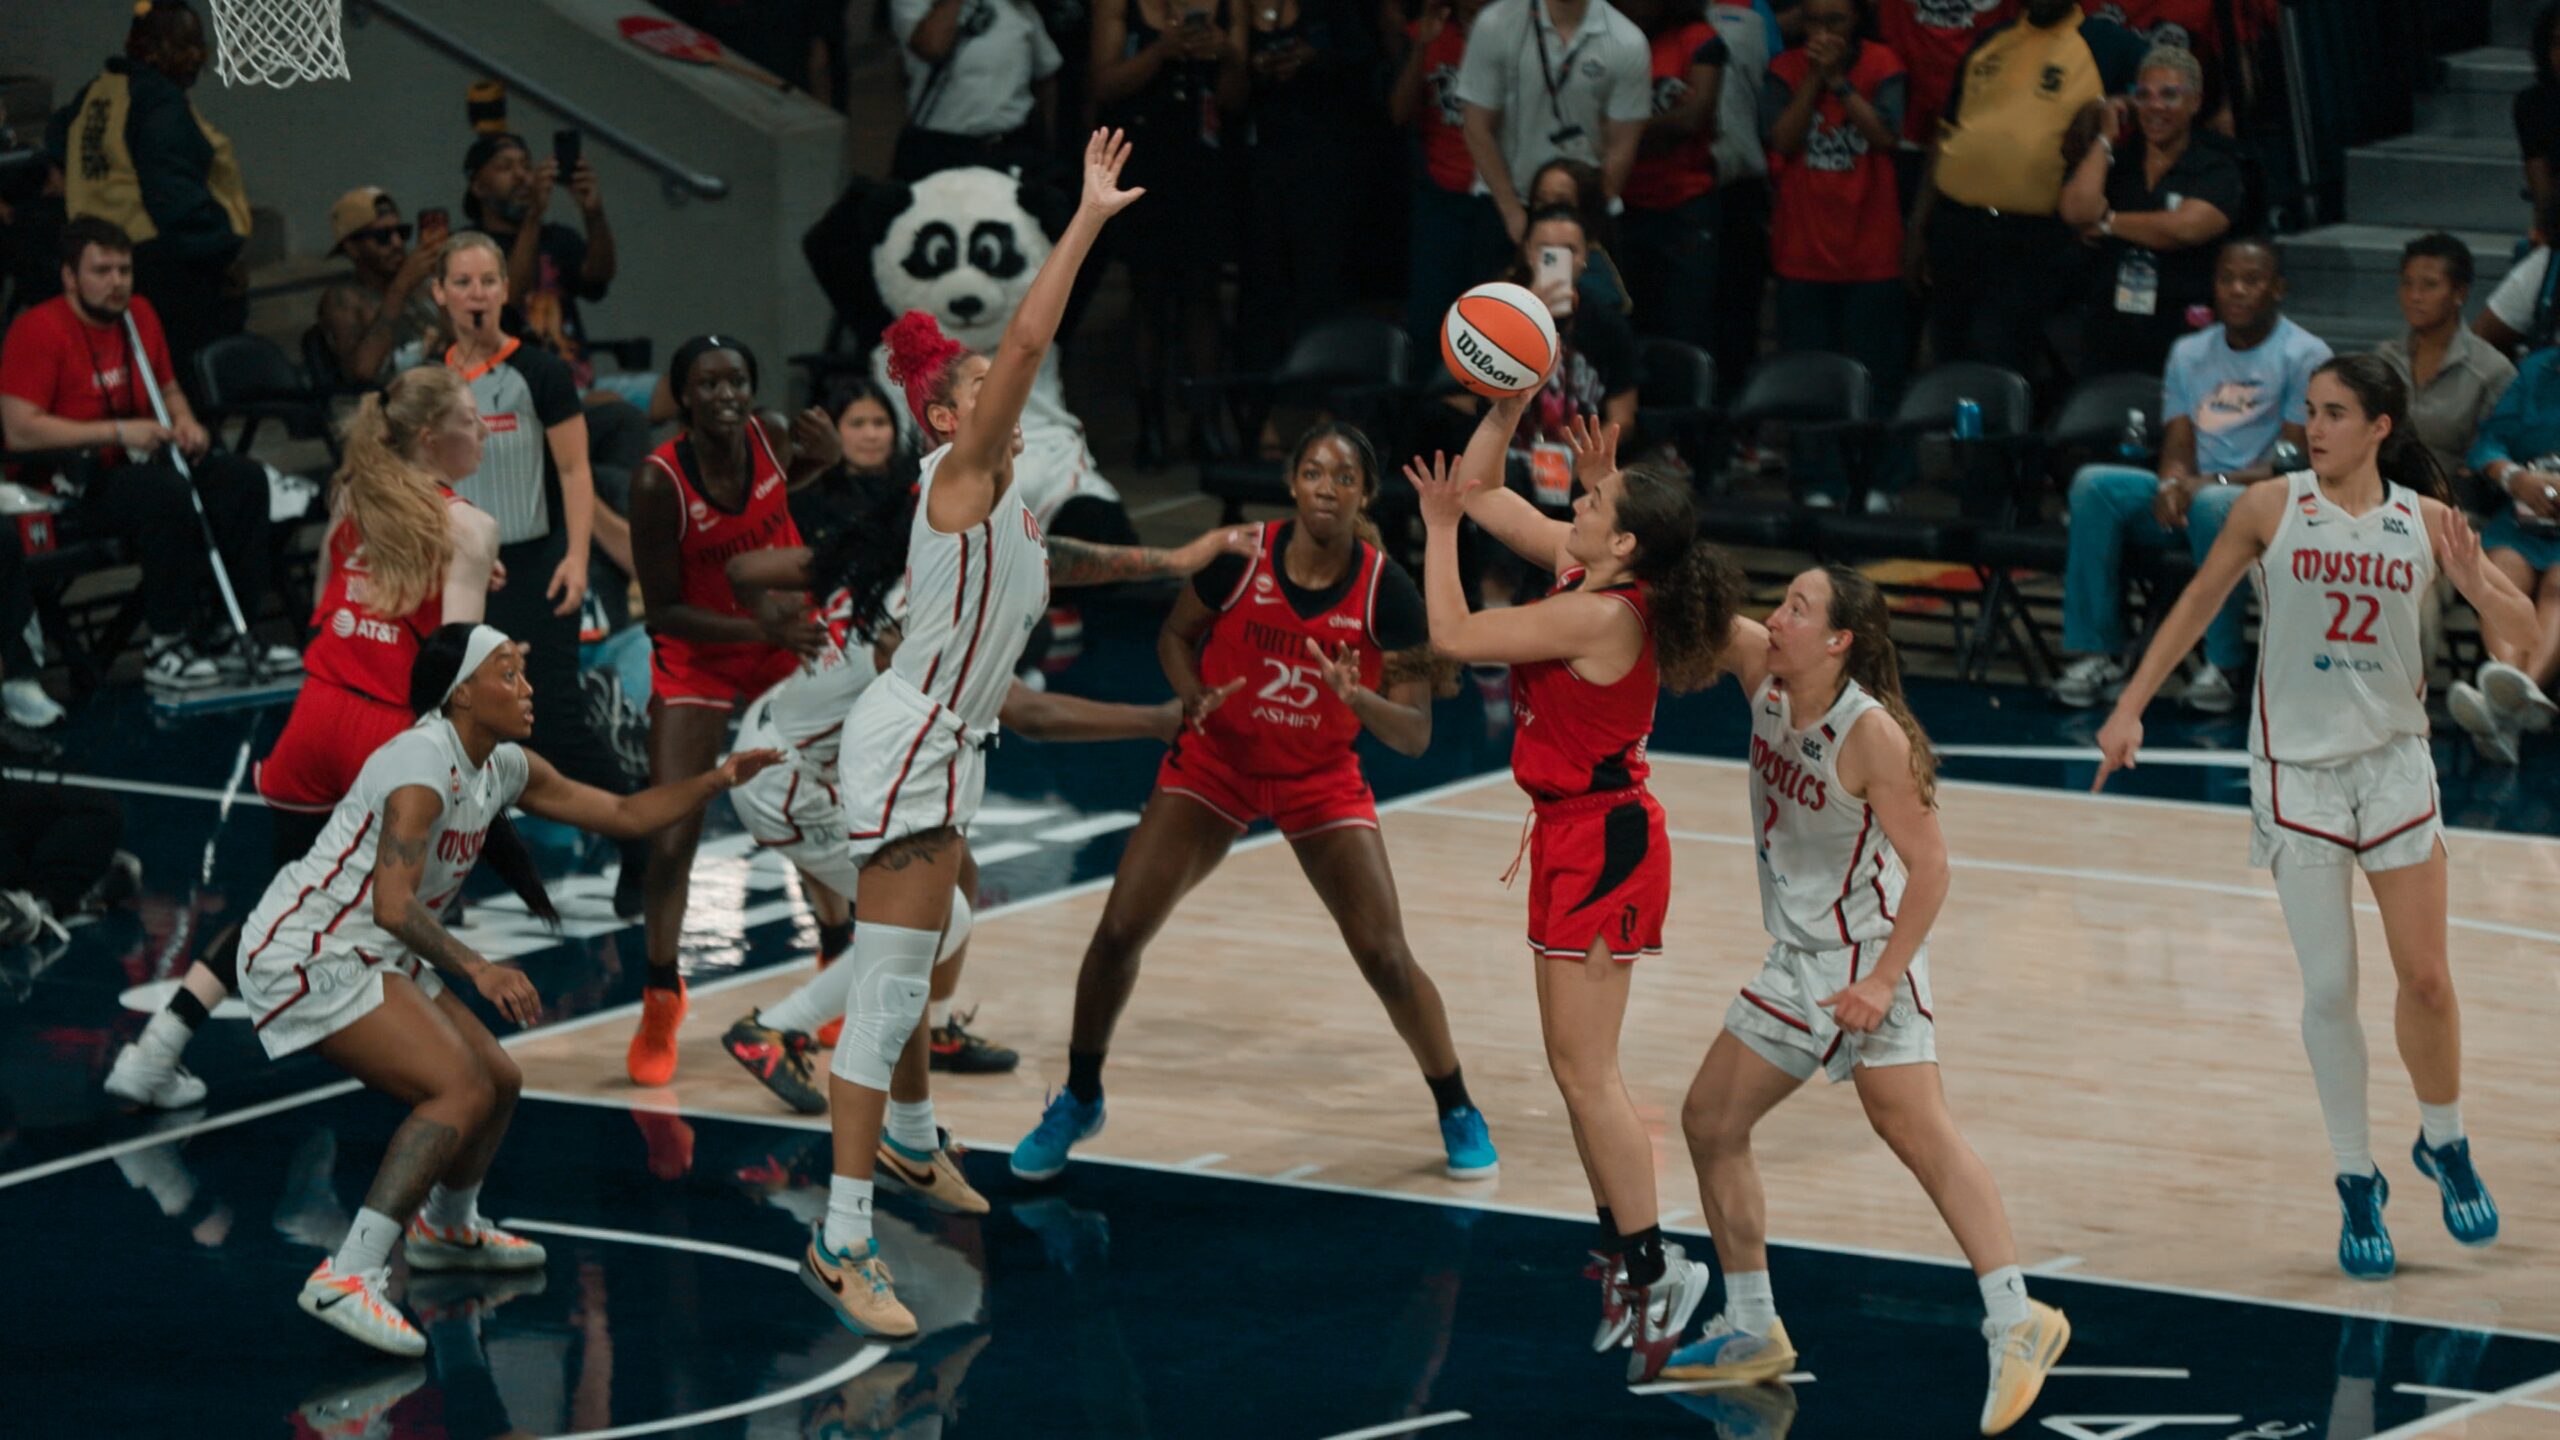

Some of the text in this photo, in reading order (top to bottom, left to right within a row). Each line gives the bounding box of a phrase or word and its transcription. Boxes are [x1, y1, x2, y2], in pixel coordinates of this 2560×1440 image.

[1457, 329, 1518, 387] Wilson
[356, 618, 400, 644] AT&T
[2325, 590, 2380, 644] 22
[1258, 657, 1322, 709] 25
